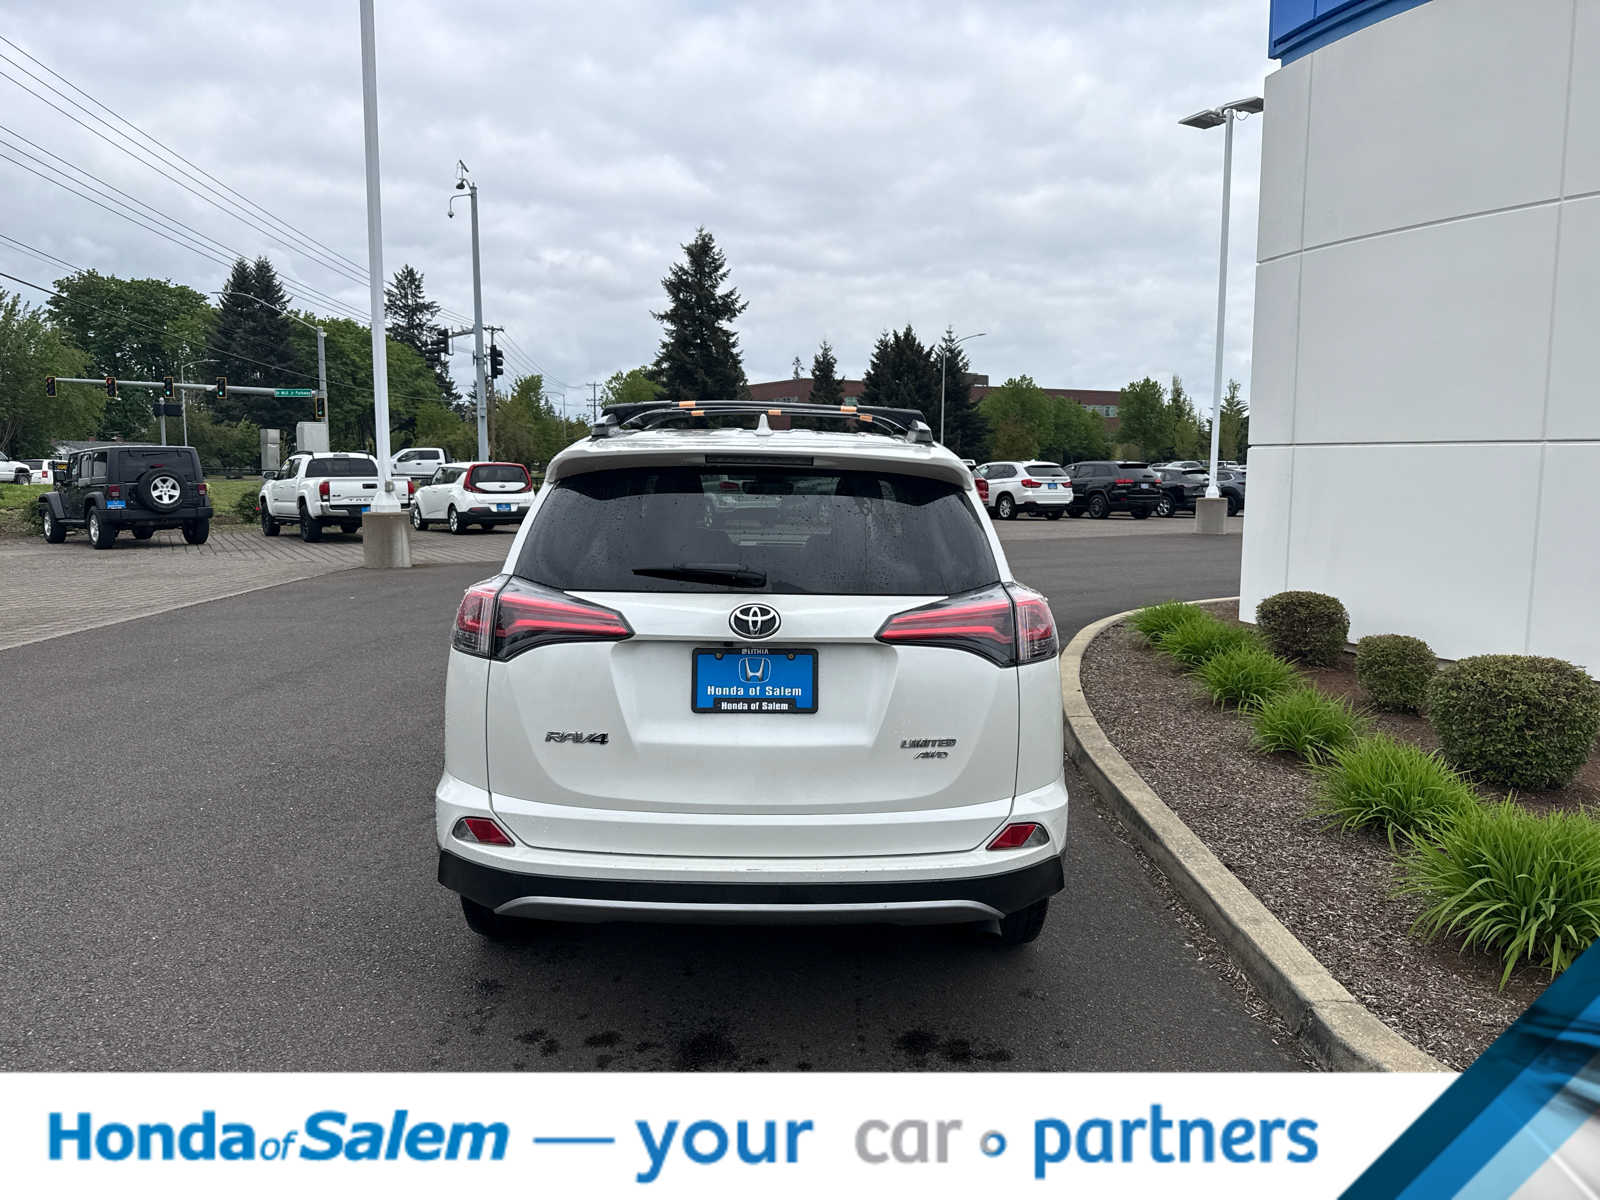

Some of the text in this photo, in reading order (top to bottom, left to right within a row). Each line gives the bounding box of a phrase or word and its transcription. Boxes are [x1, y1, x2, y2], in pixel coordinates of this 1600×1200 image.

[707, 685, 802, 696] Honda of Salem
[721, 701, 789, 710] Honda of Salem
[545, 731, 609, 744] RAV4
[900, 739, 957, 749] LIMITED
